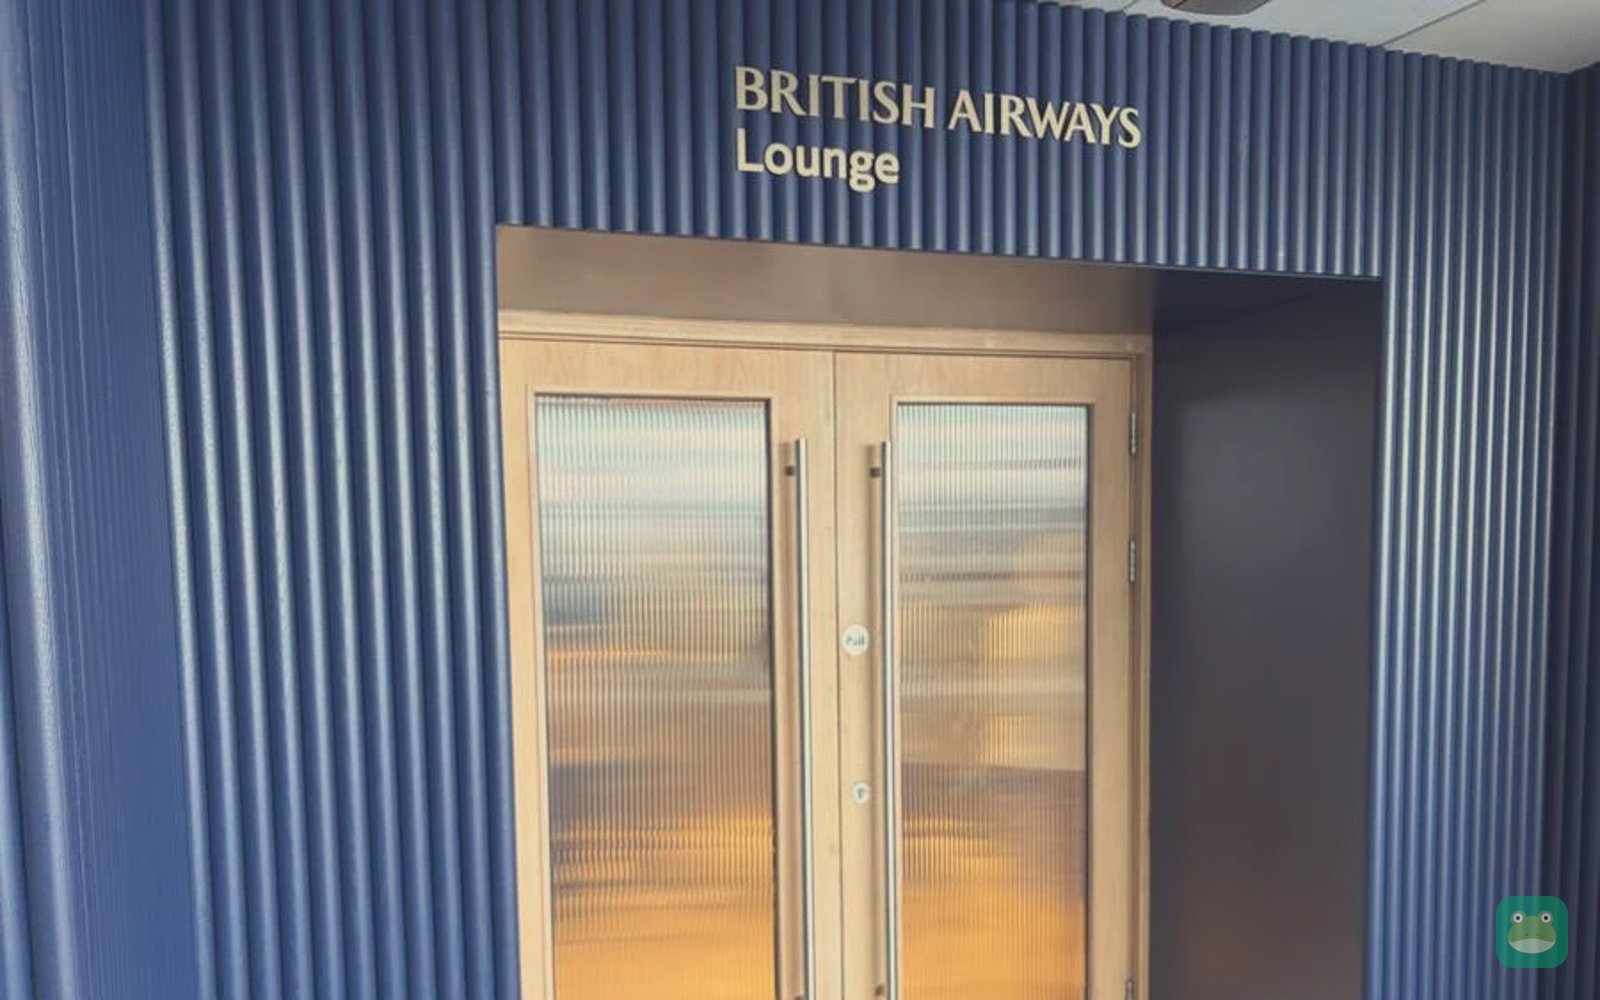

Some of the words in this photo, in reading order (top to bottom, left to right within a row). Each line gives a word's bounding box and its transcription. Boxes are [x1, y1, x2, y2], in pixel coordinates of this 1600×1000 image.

[735, 66, 935, 129] BRITISH
[948, 90, 1141, 149] AIRWAYS
[736, 128, 900, 193] Lounge
